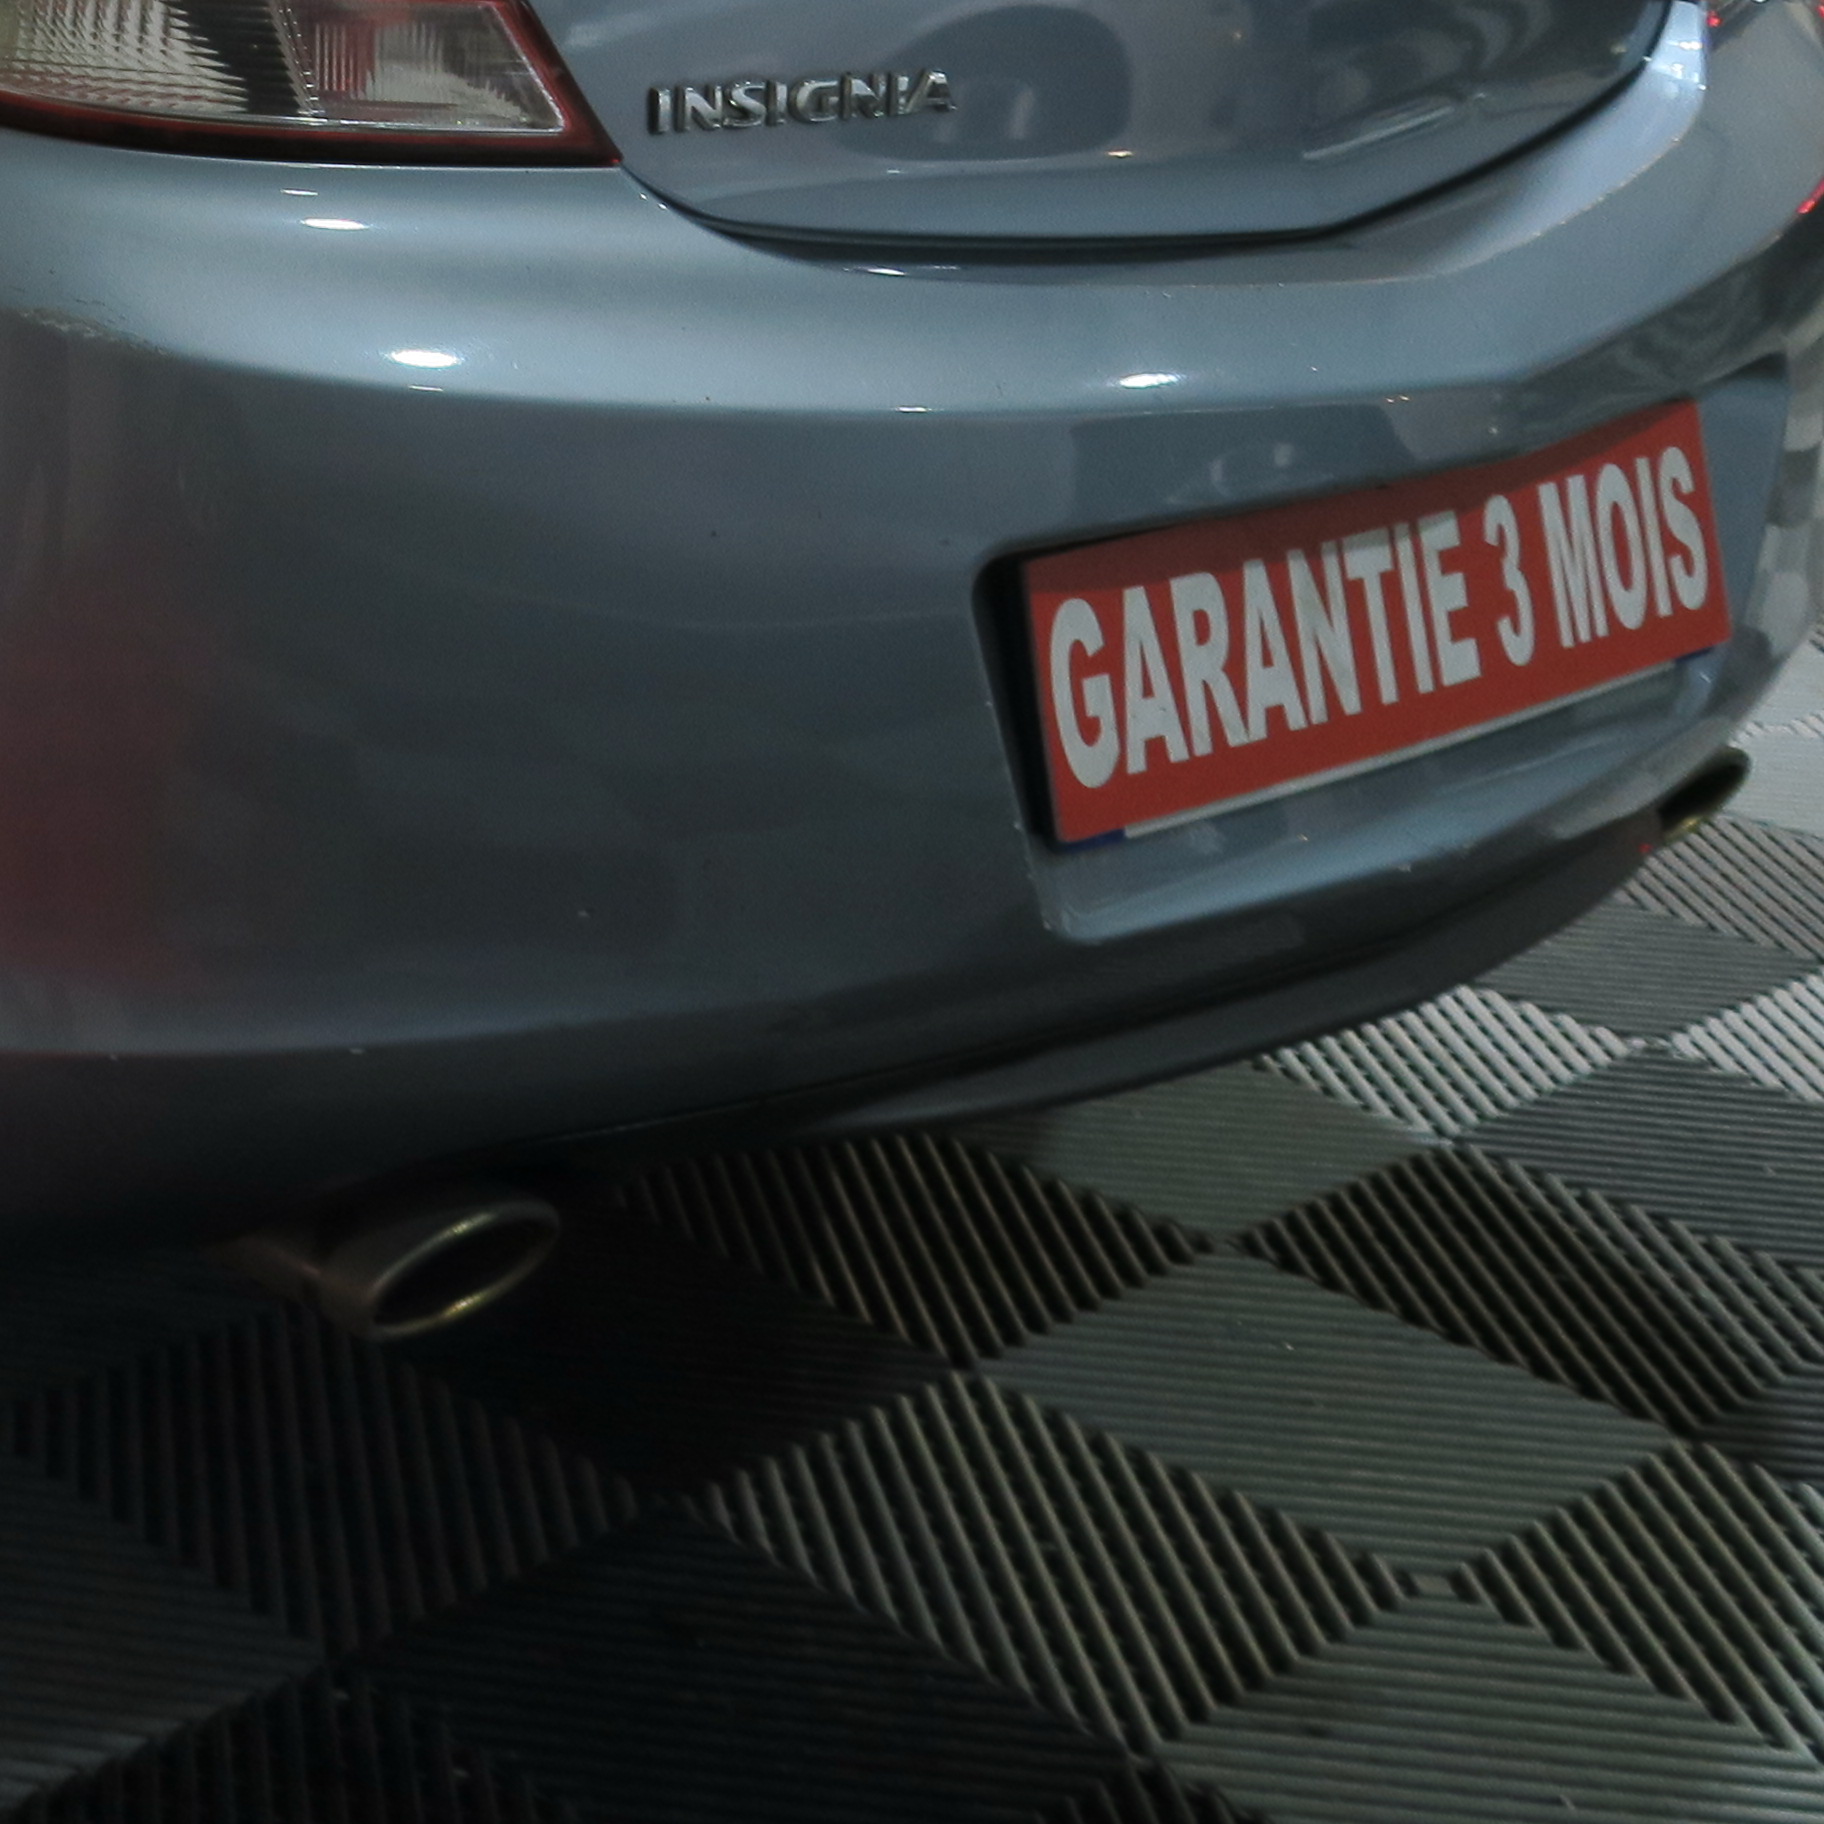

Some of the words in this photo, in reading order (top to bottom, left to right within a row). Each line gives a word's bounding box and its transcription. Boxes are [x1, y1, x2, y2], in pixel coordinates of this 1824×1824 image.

[649, 68, 957, 134] INSIGNIA
[1050, 509, 1482, 789] GARANTIE
[1484, 494, 1536, 667] 3
[1538, 446, 1708, 649] MOIS
